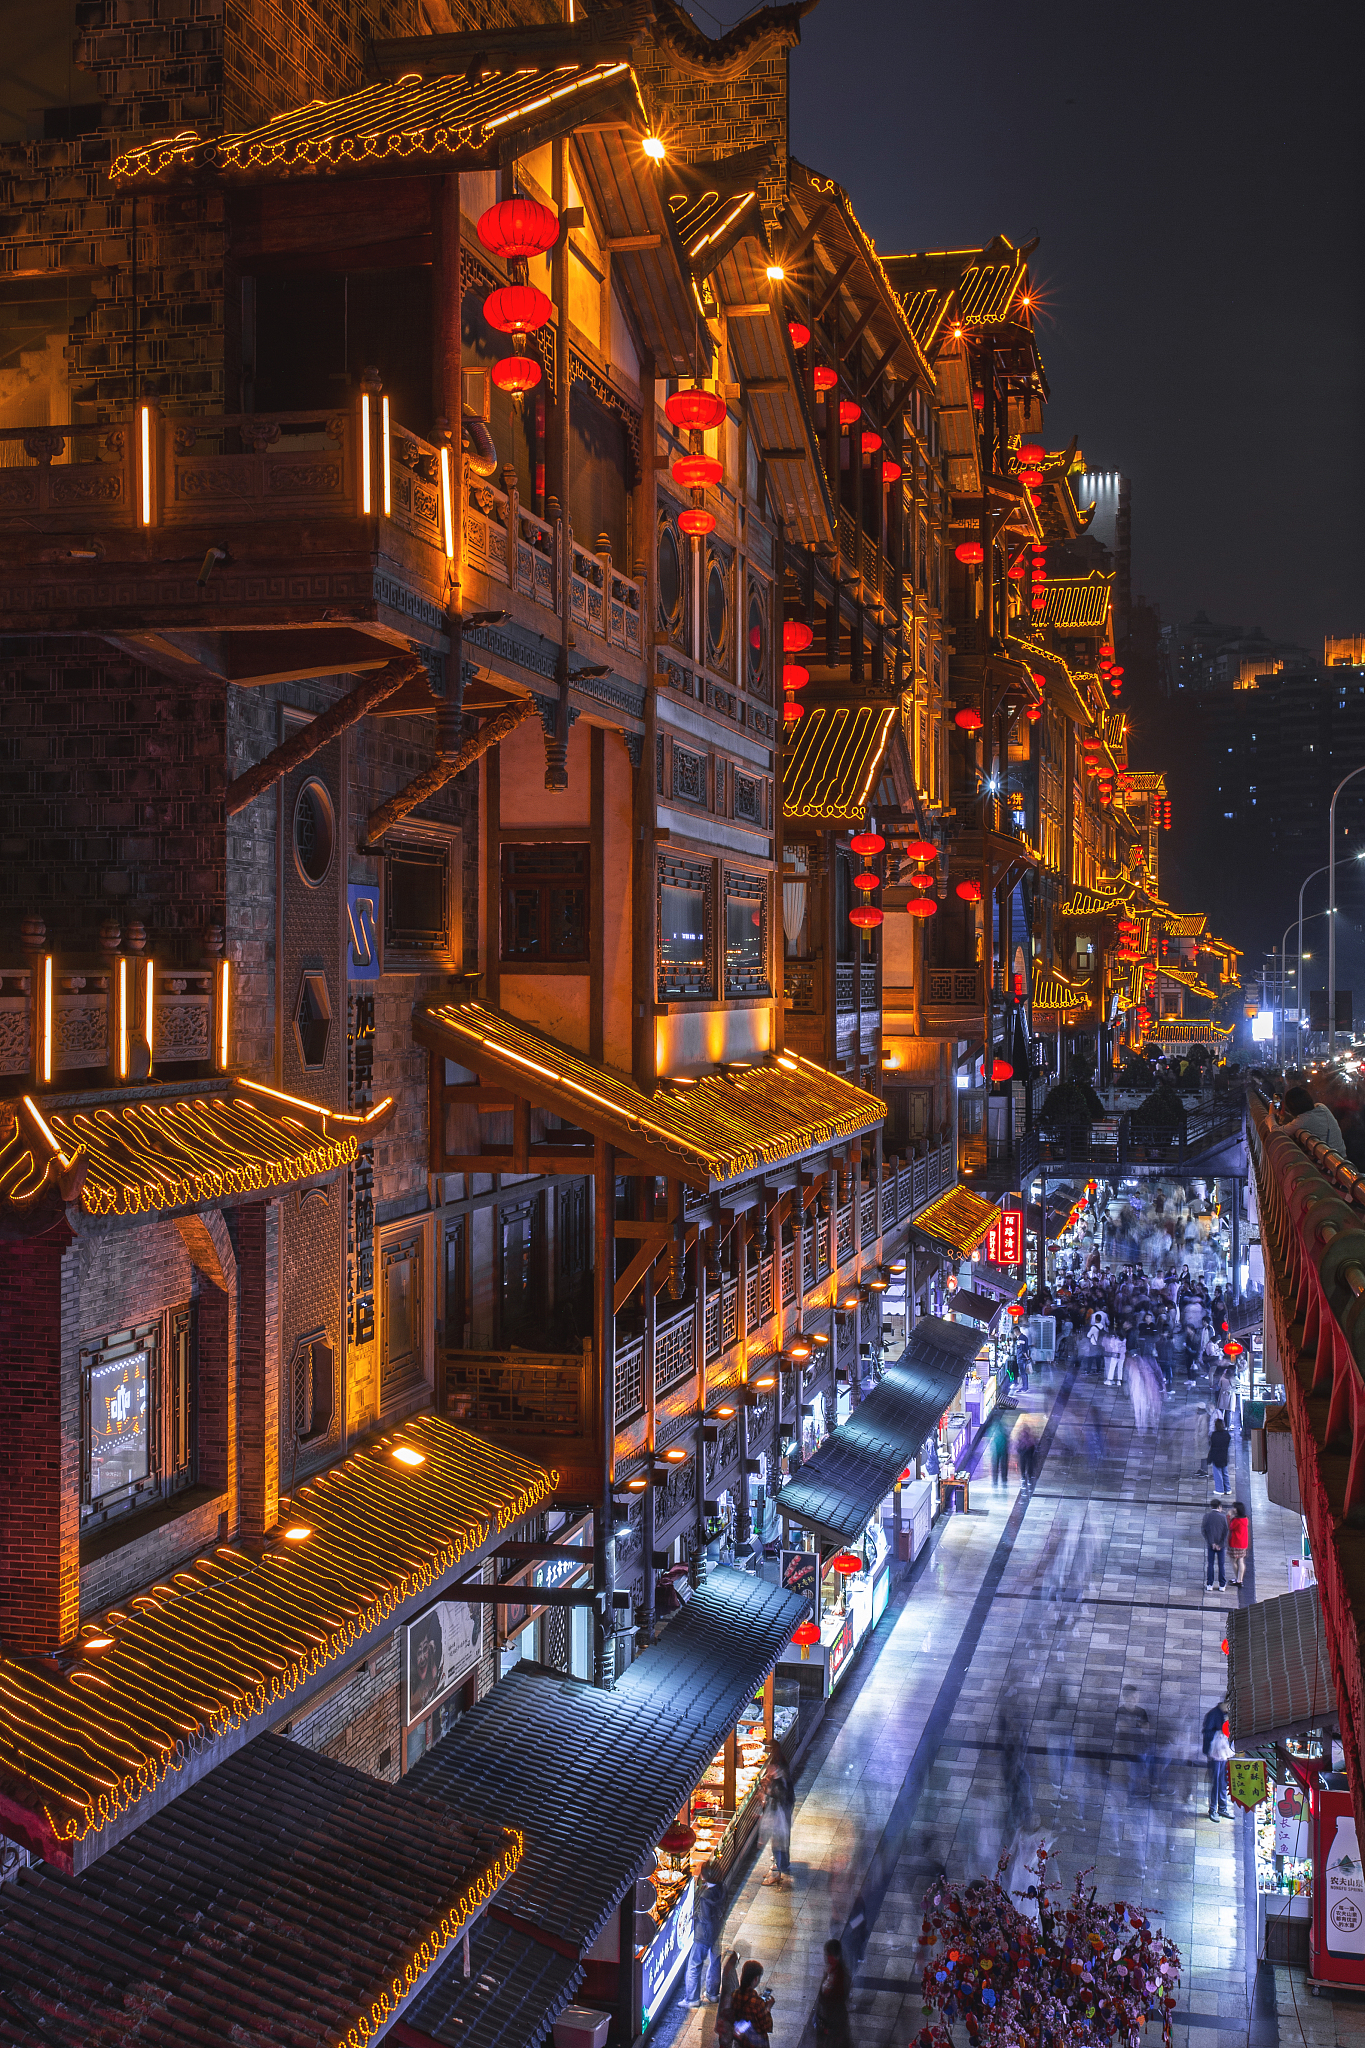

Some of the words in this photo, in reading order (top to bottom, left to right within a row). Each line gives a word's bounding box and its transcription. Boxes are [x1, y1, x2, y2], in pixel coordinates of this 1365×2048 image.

[1004, 1216, 1015, 1259] 陌路清吧
[1278, 1817, 1291, 1855] 长江鱼
[1330, 1877, 1364, 1888] 农夫山泉
